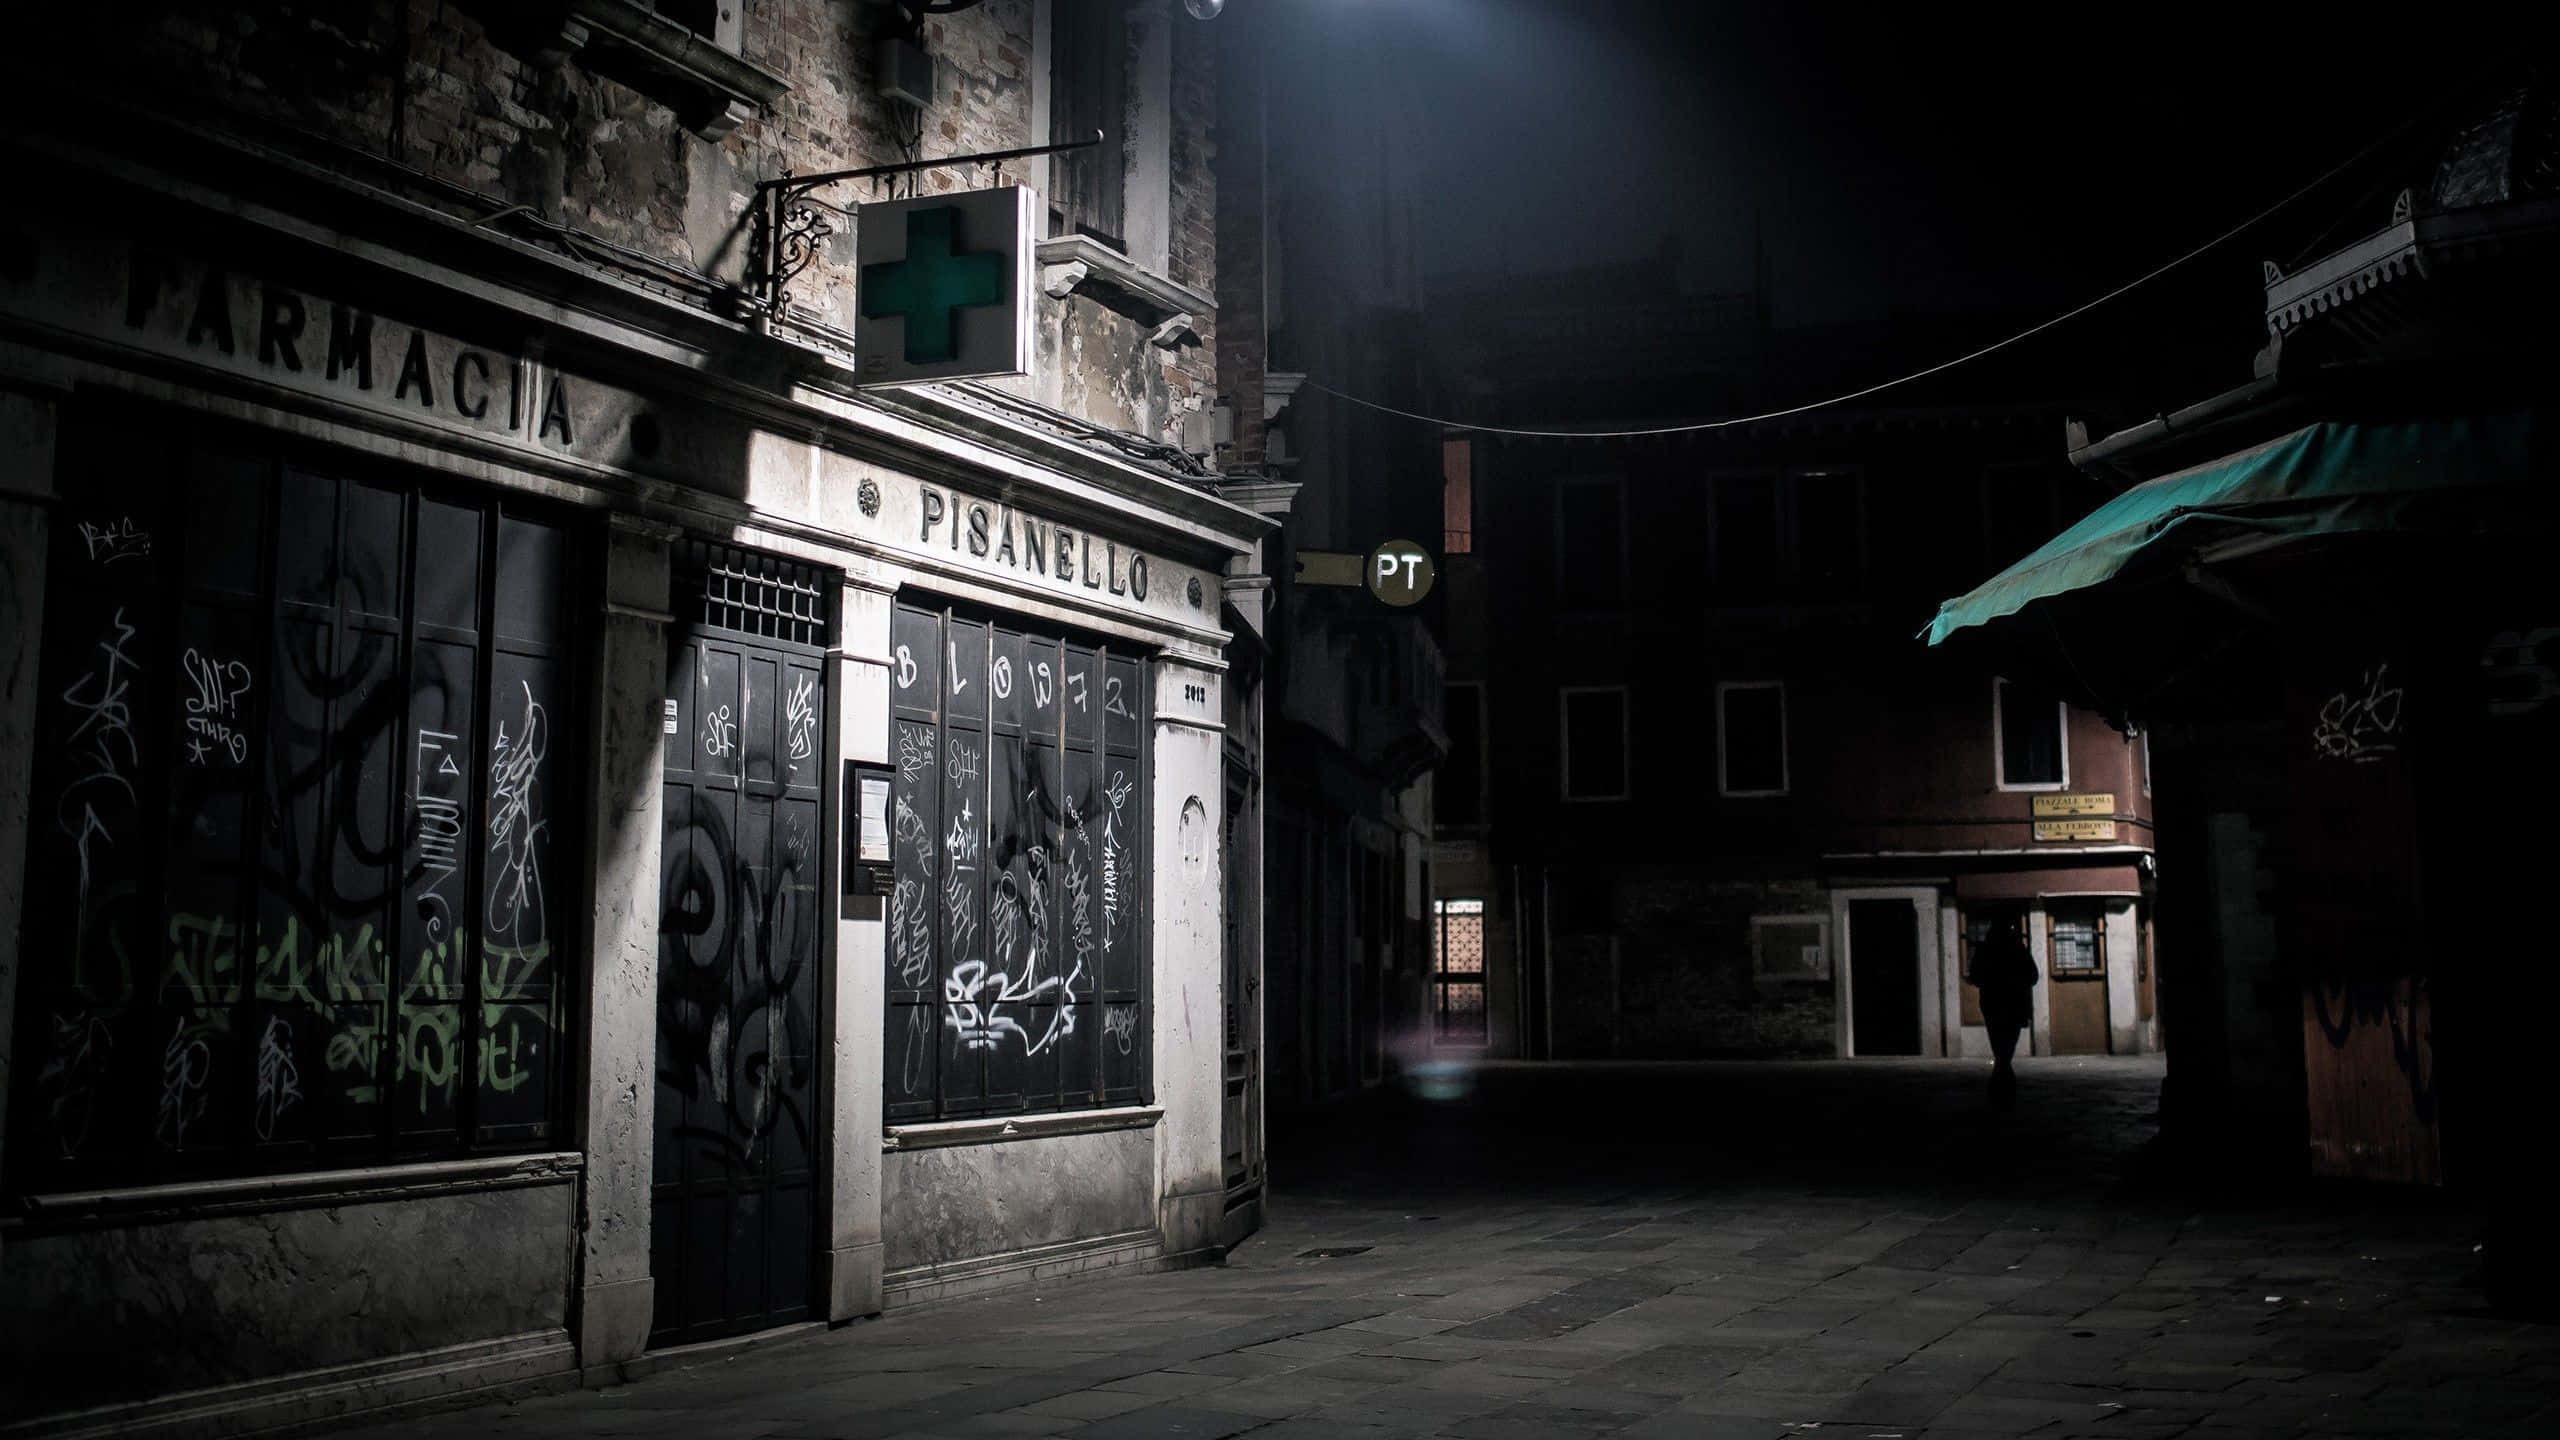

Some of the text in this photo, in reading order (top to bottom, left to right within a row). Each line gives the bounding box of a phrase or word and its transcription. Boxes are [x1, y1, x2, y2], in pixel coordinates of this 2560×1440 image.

[126, 240, 572, 446] FARMACIA
[919, 484, 1148, 602] PISANELLO
[1375, 553, 1424, 590] PT
